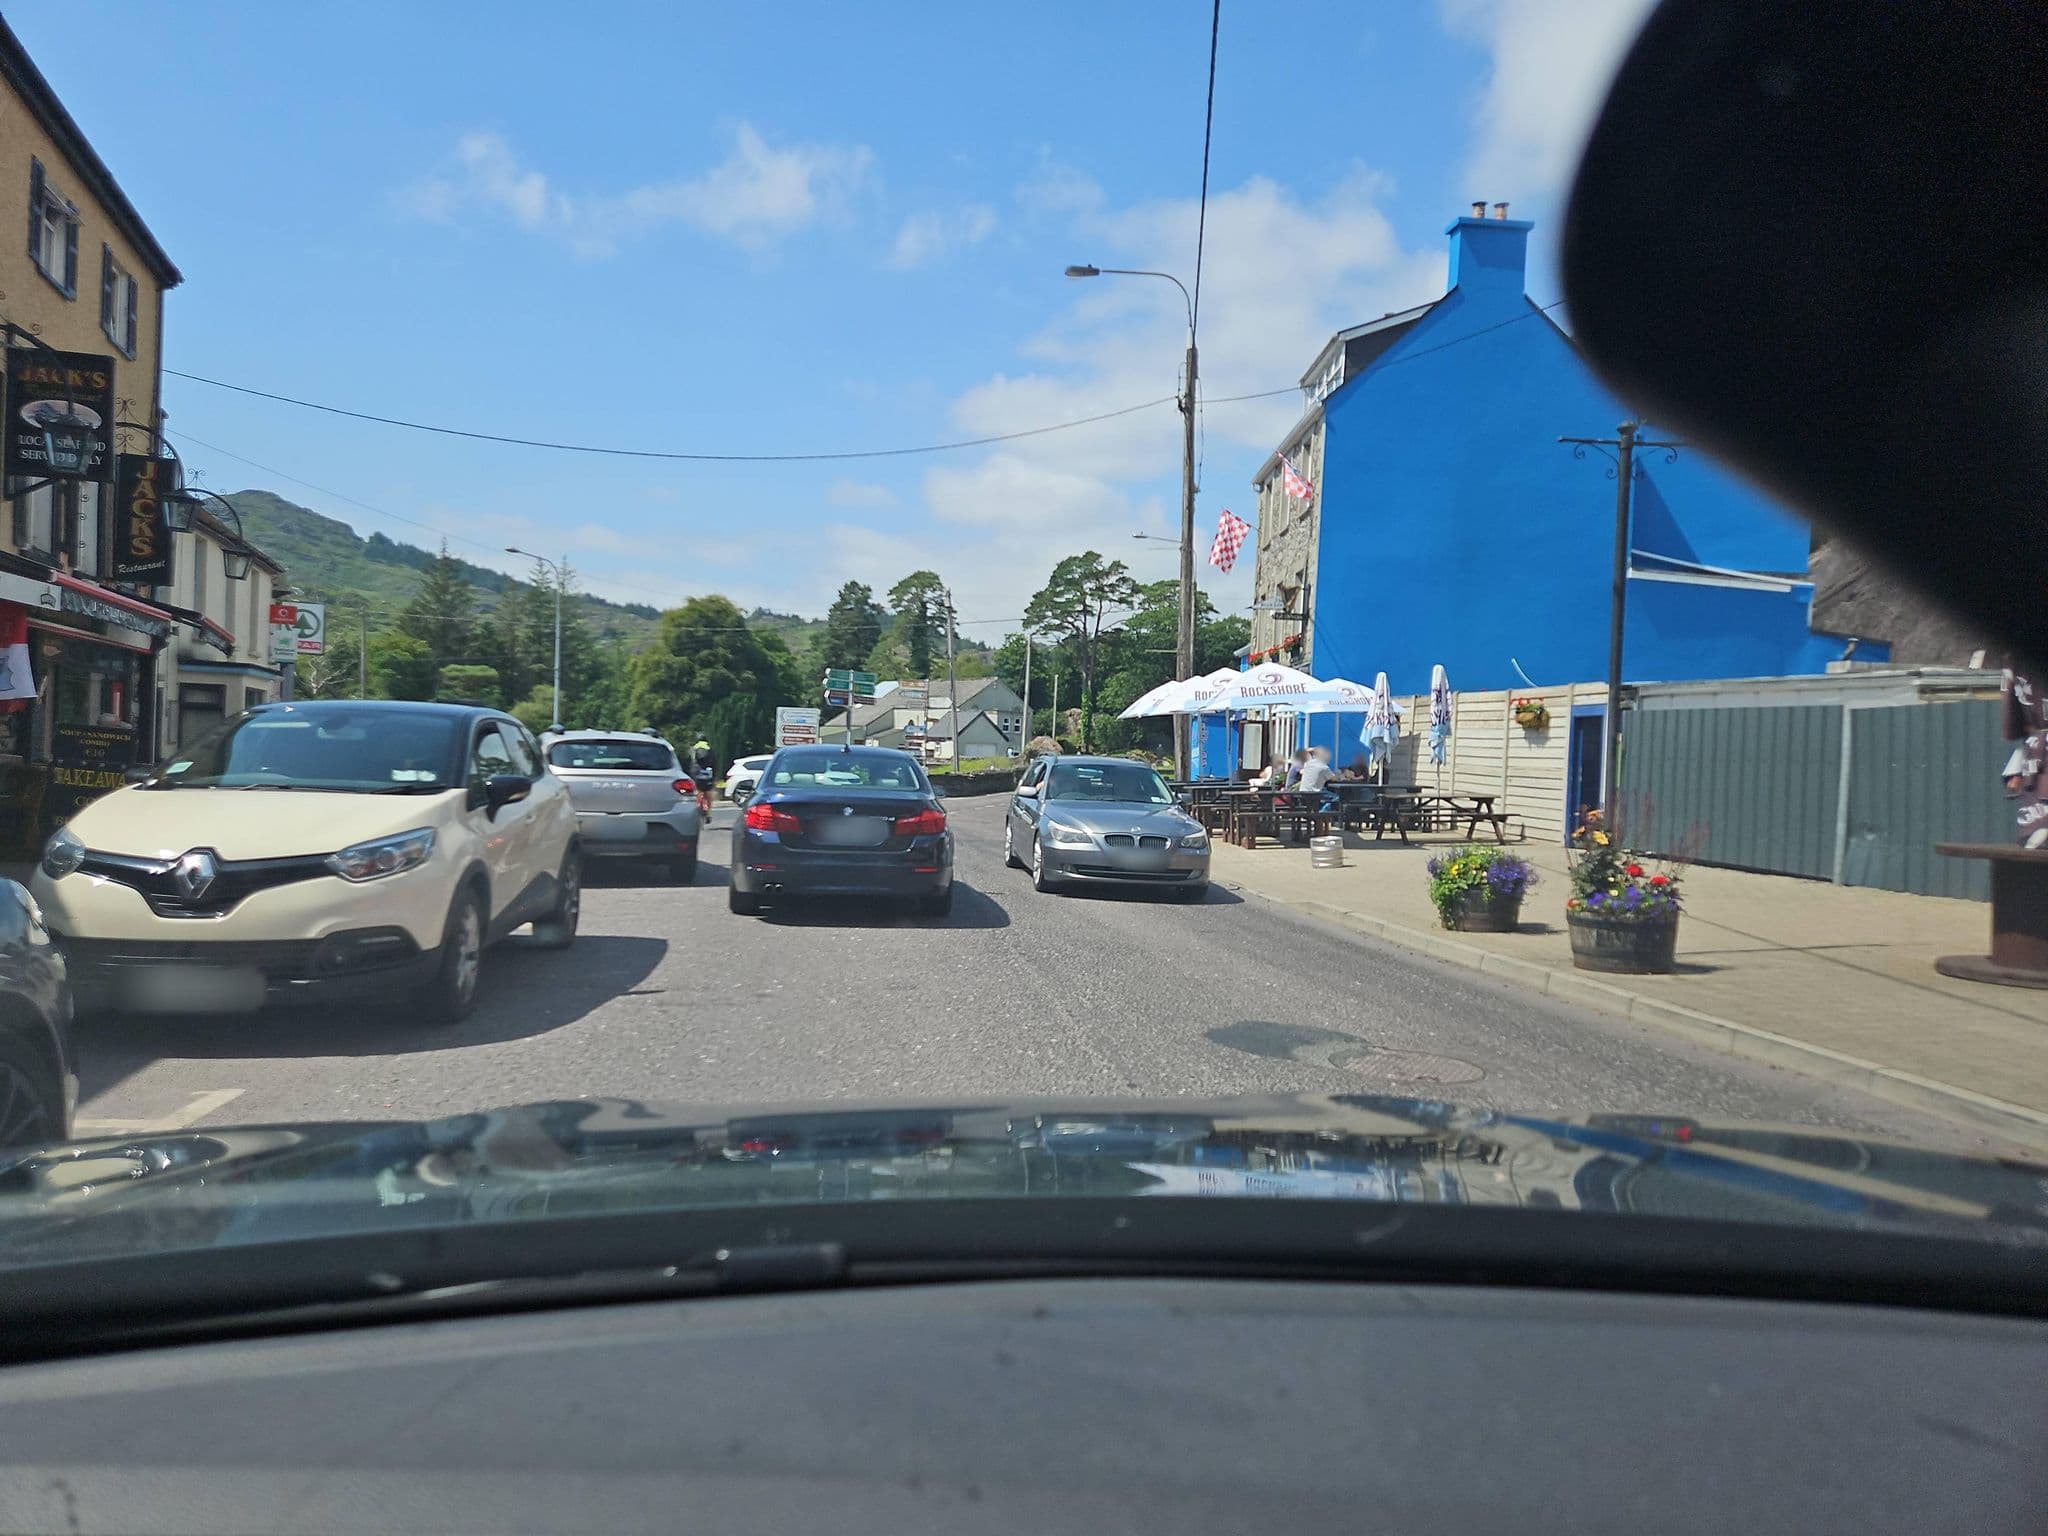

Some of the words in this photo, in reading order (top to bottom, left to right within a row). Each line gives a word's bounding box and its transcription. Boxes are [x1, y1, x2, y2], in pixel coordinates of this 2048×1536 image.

[17, 367, 107, 389] JACK'S
[131, 461, 157, 557] JACKS
[118, 560, 166, 573] Restaurant
[1240, 683, 1309, 698] ROCKSHORE
[54, 767, 126, 789] TAKEAWA
